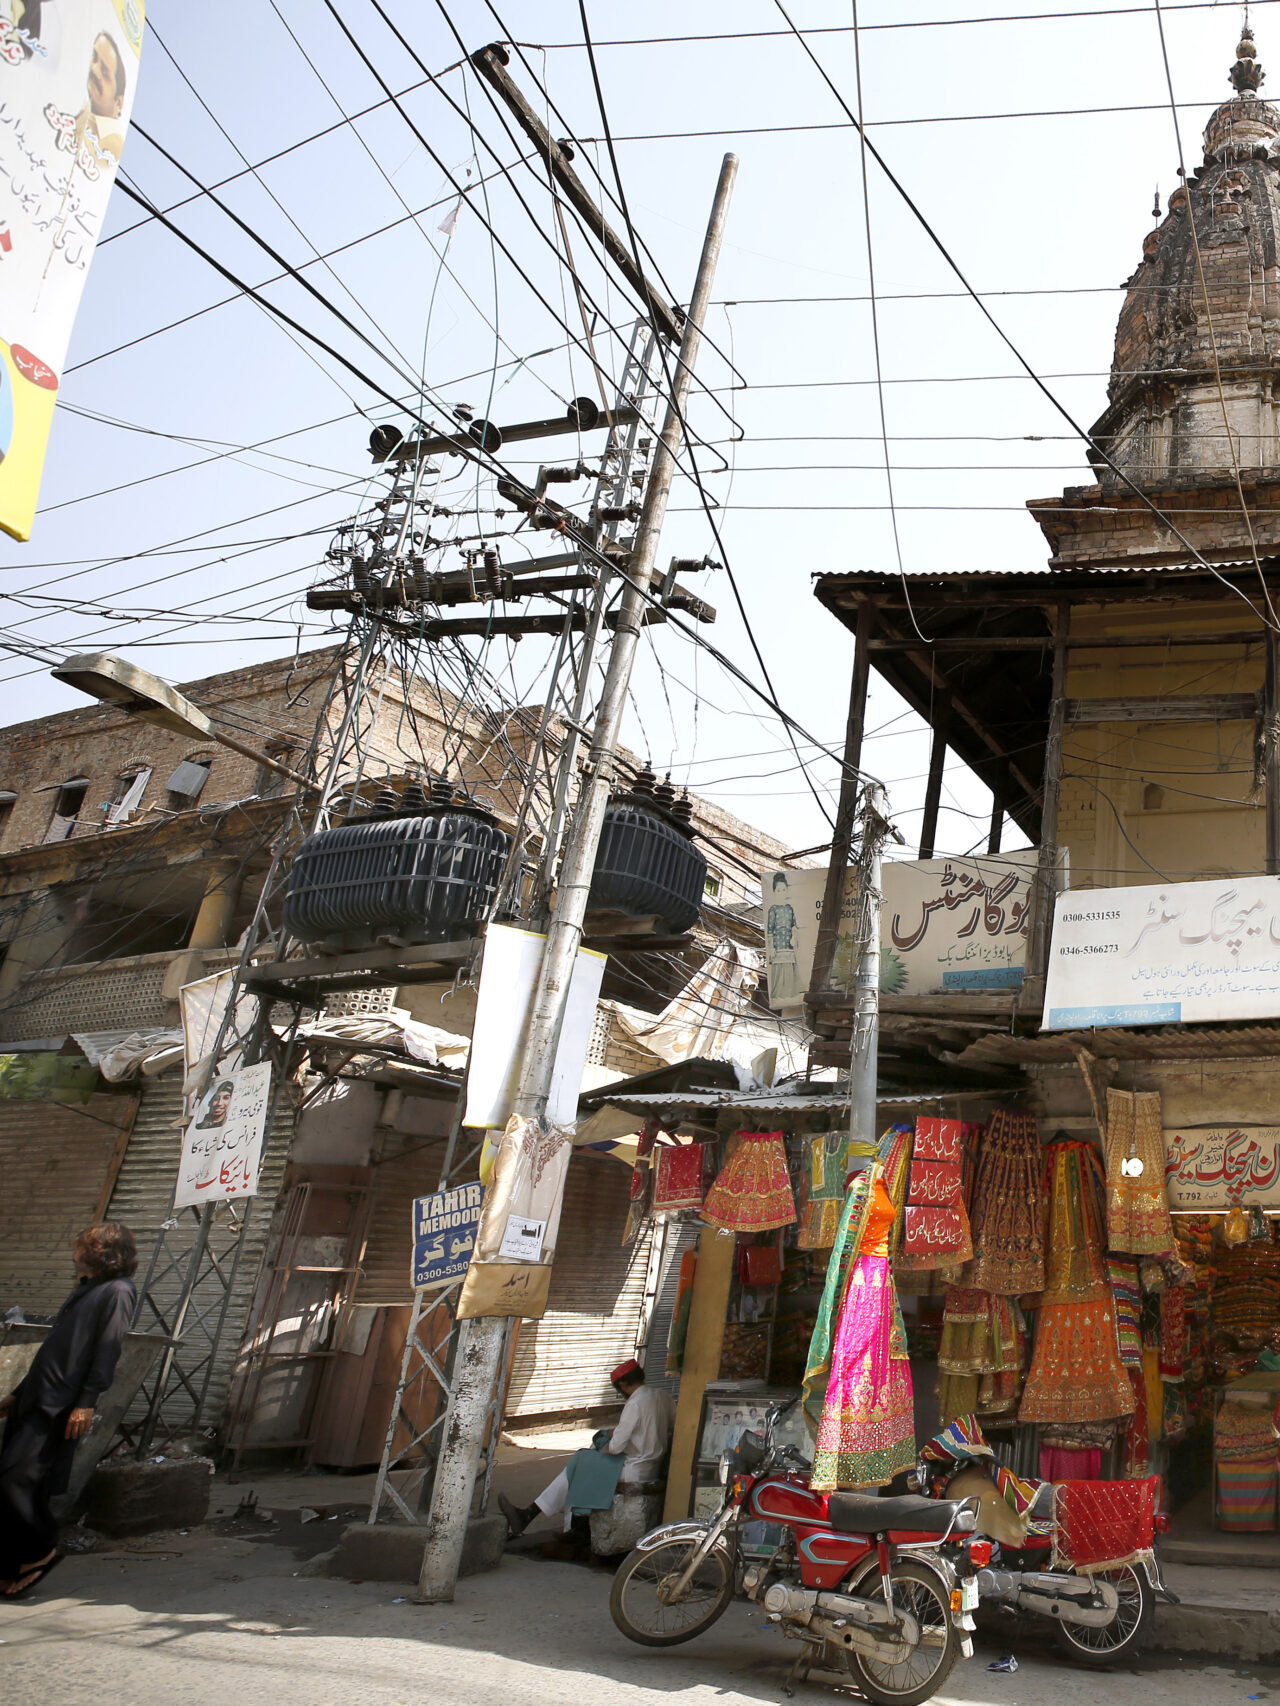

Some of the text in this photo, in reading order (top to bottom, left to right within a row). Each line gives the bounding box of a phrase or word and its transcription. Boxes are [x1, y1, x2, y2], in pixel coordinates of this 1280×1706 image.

[1062, 910, 1121, 923] 0300-5331535
[1178, 888, 1266, 956] میچنگ
[1059, 944, 1119, 956] 0346-5366273
[227, 1125, 257, 1150] فرانس
[420, 1185, 481, 1220] TAHIR
[1177, 1192, 1202, 1201] T.792
[420, 1206, 481, 1236] MEMOOD
[417, 1261, 469, 1282] 0300-5380
